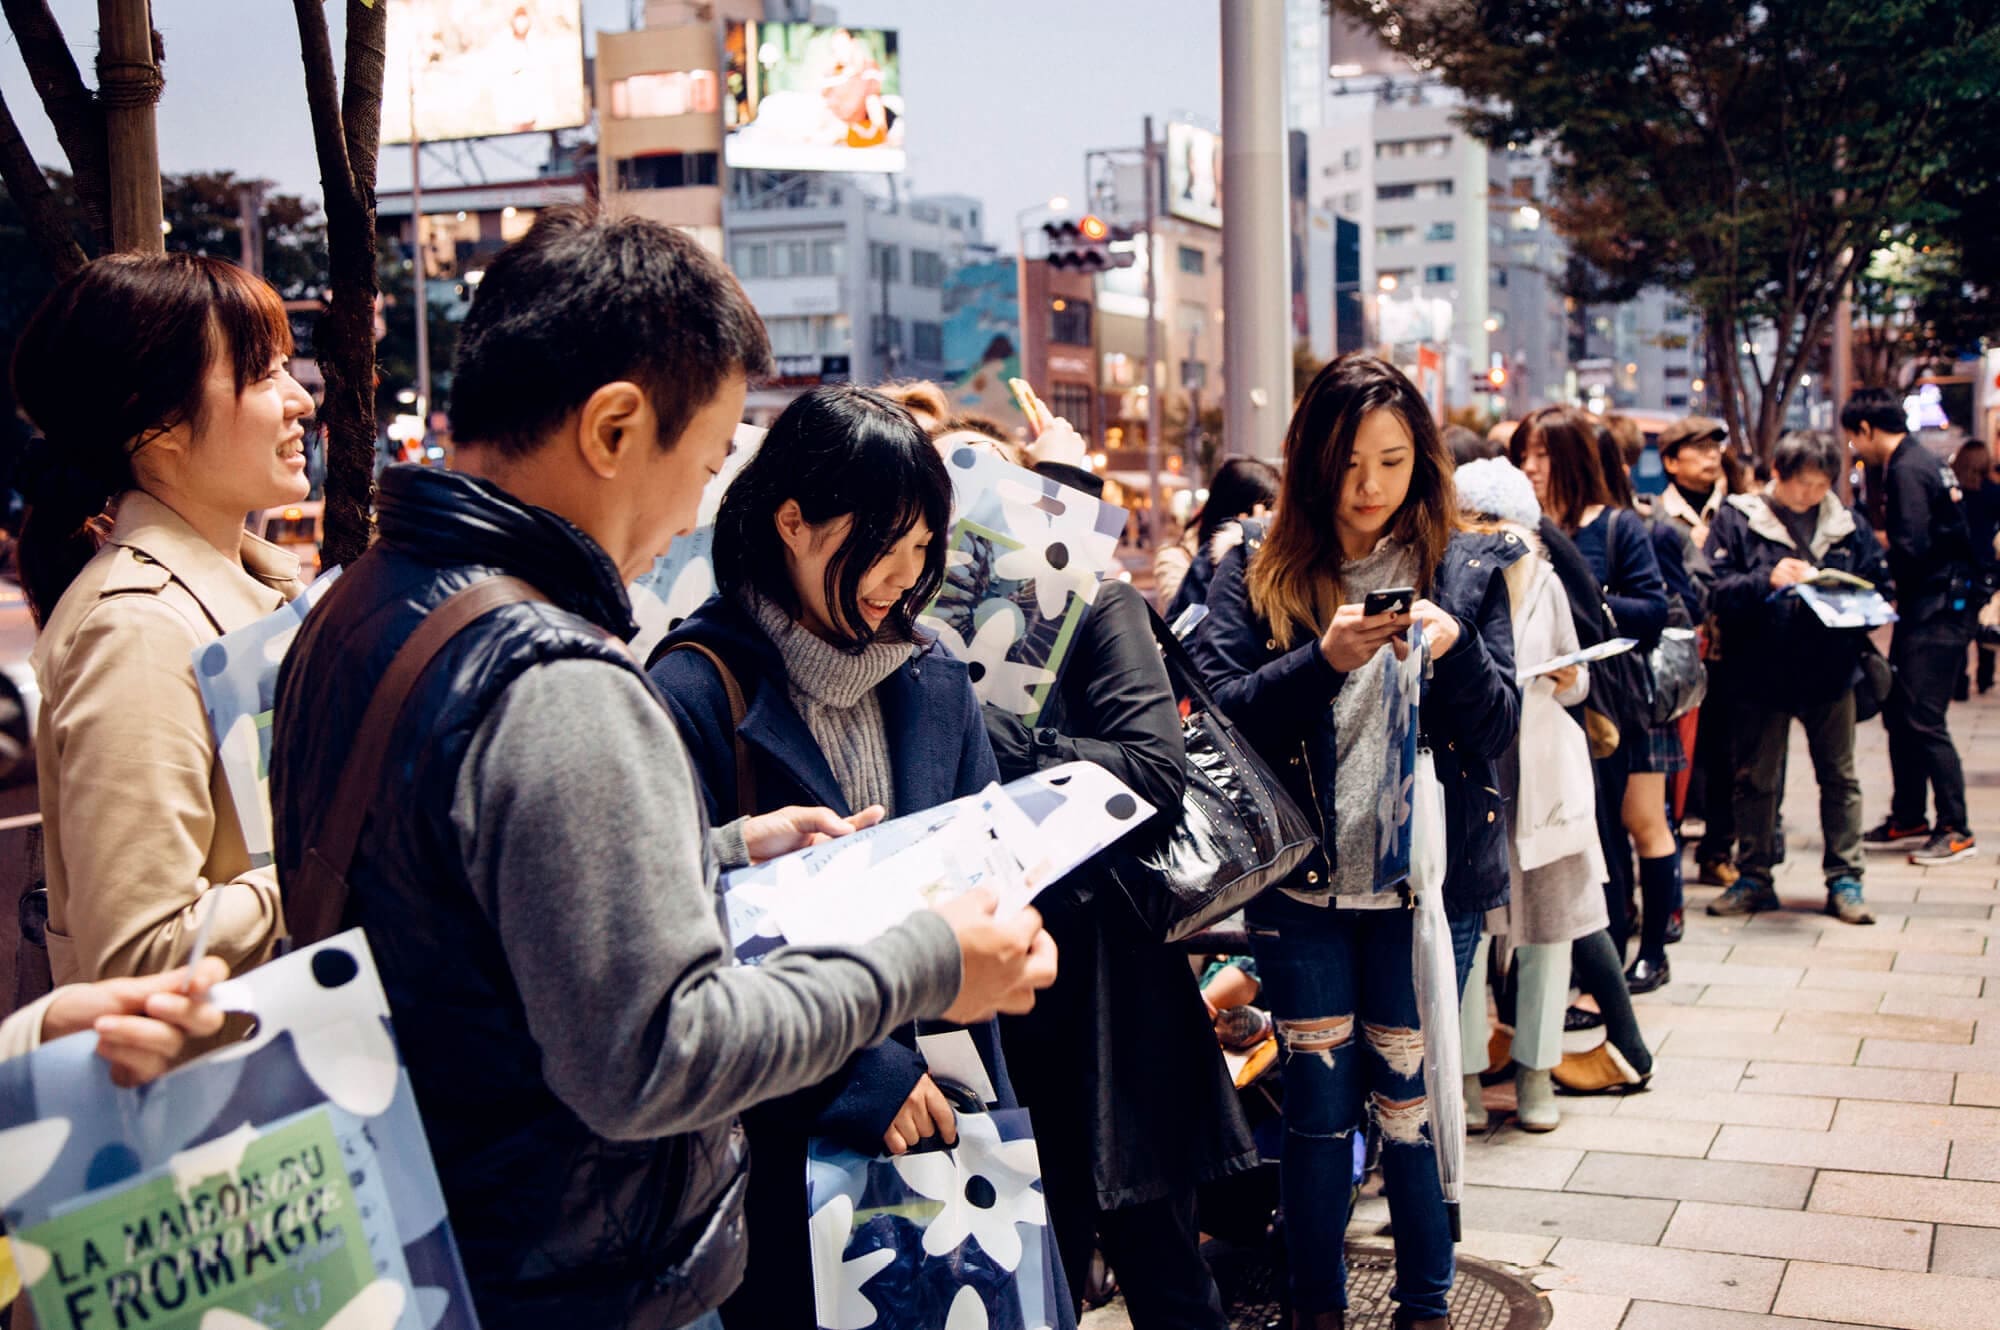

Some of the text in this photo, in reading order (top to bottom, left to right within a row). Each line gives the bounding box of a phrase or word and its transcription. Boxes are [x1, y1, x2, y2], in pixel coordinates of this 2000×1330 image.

[53, 1239, 107, 1285] LA
[123, 1172, 264, 1257] MAISON
[64, 1186, 338, 1330] FROMAGE
